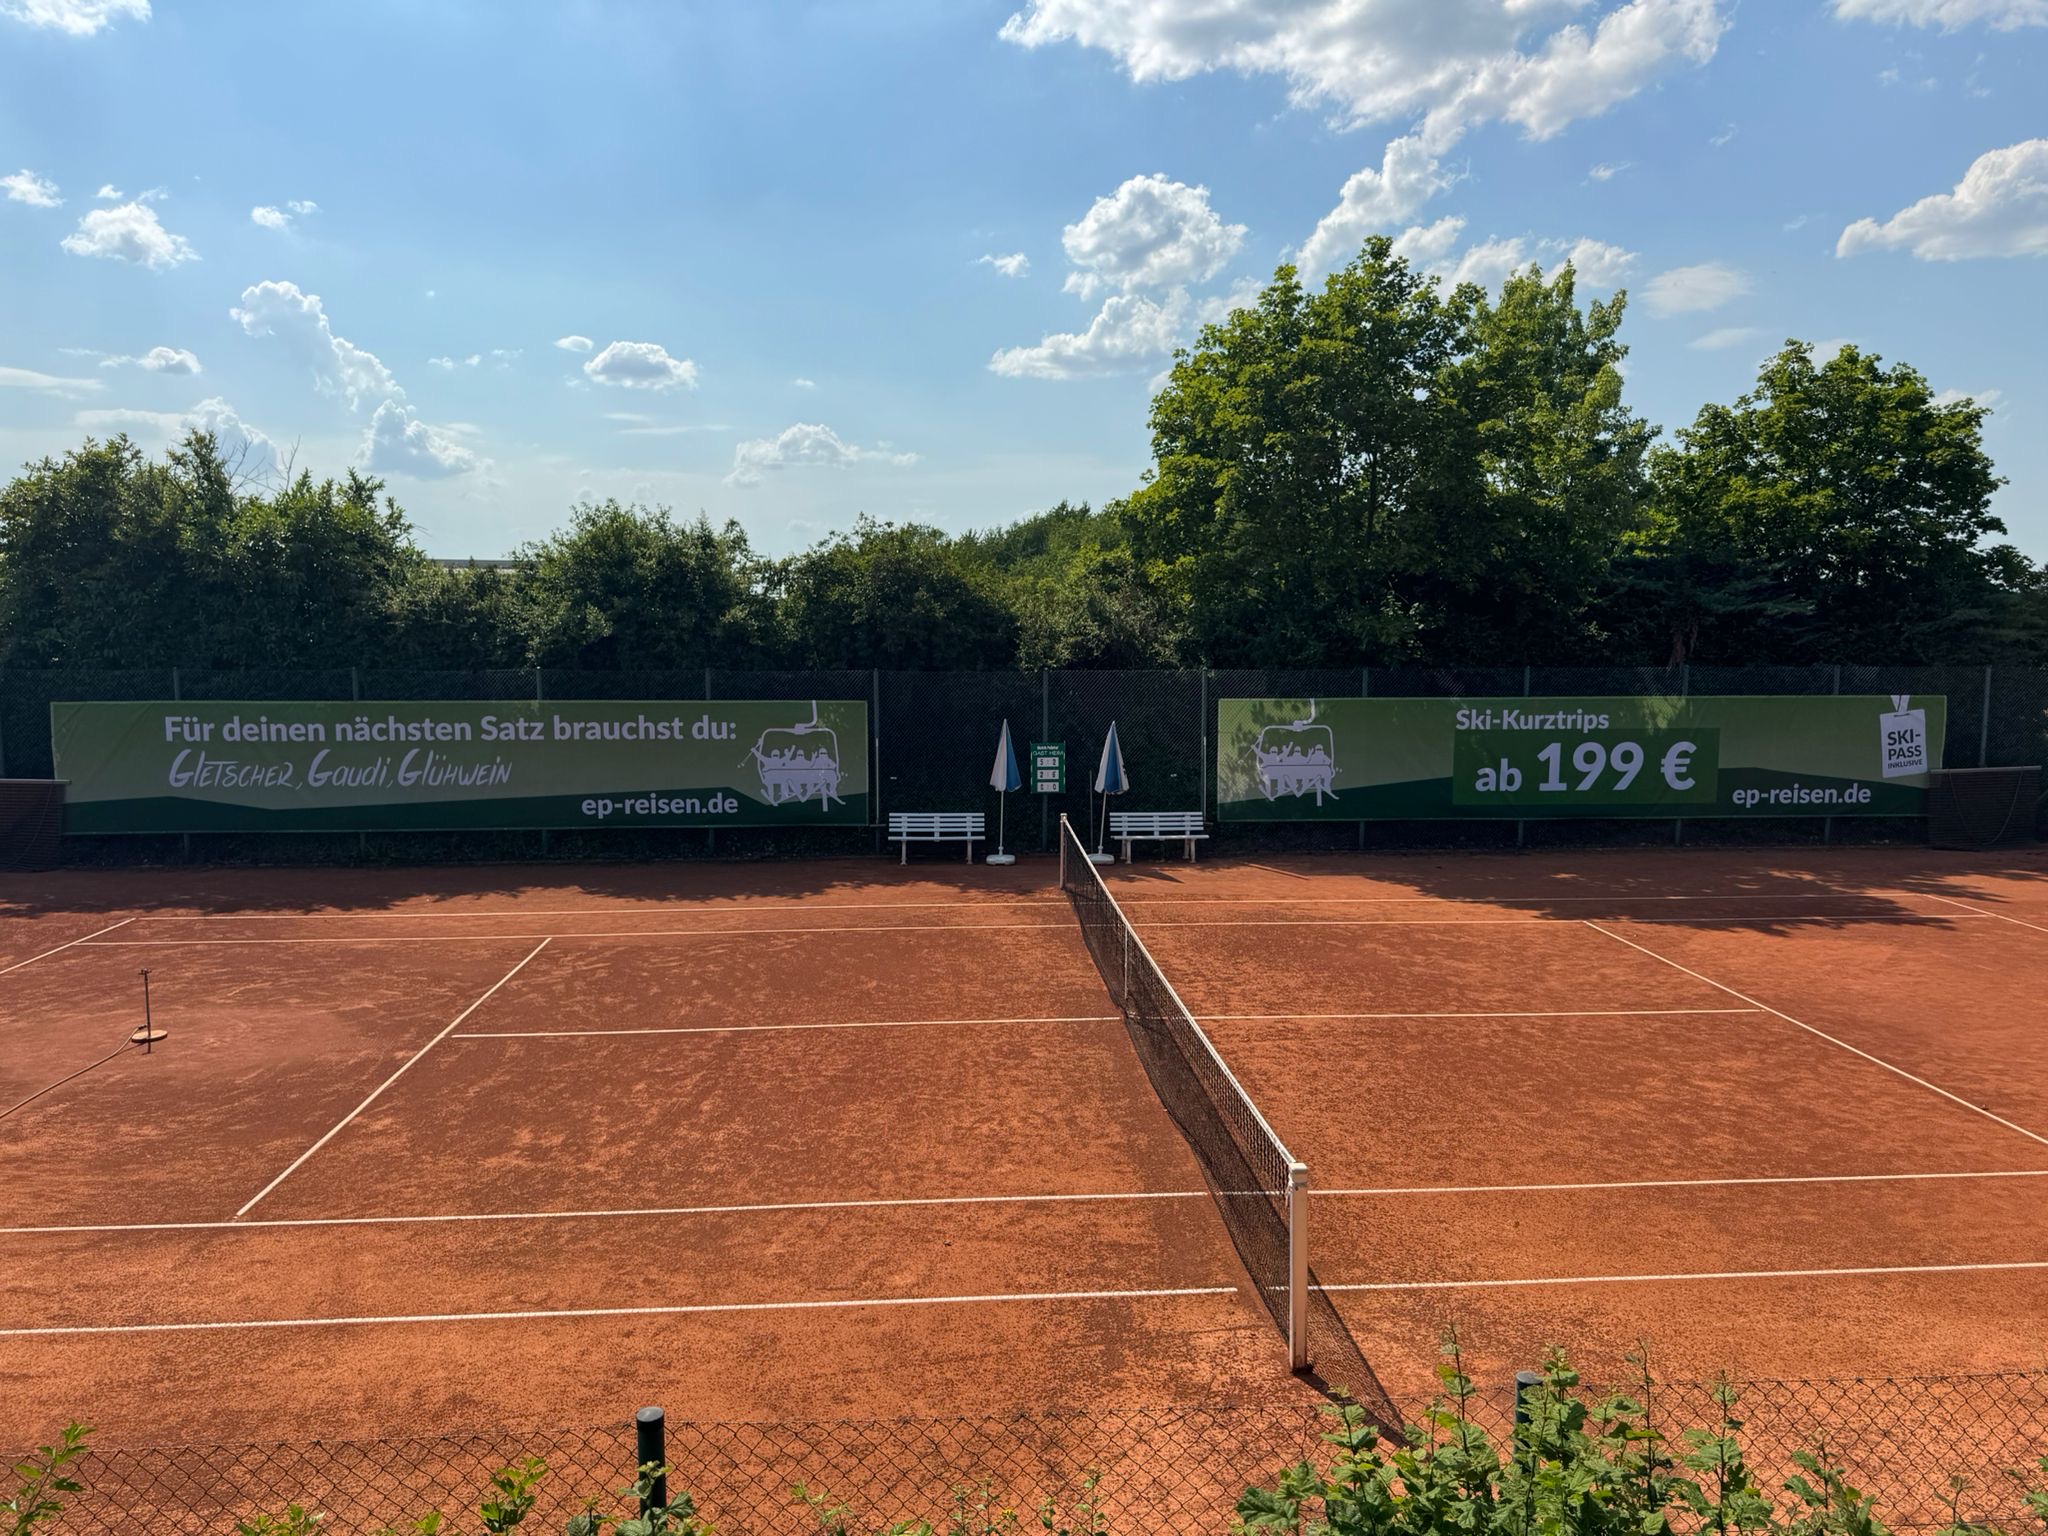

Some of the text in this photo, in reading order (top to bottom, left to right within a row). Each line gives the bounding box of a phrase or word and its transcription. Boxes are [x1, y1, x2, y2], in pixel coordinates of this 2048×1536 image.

[164, 713, 738, 743] Für deinen nächsten Satz brauchst du:
[1456, 709, 1609, 732] Ski-Kurztrips
[1887, 728, 1921, 746] SKI-
[1888, 745, 1922, 760] PASS
[1888, 758, 1922, 769] INKLUSIVE
[1475, 741, 1698, 792] ab 199 €
[581, 792, 739, 820] ep-reisen.de
[1732, 783, 1872, 809] ep-reisen.de
